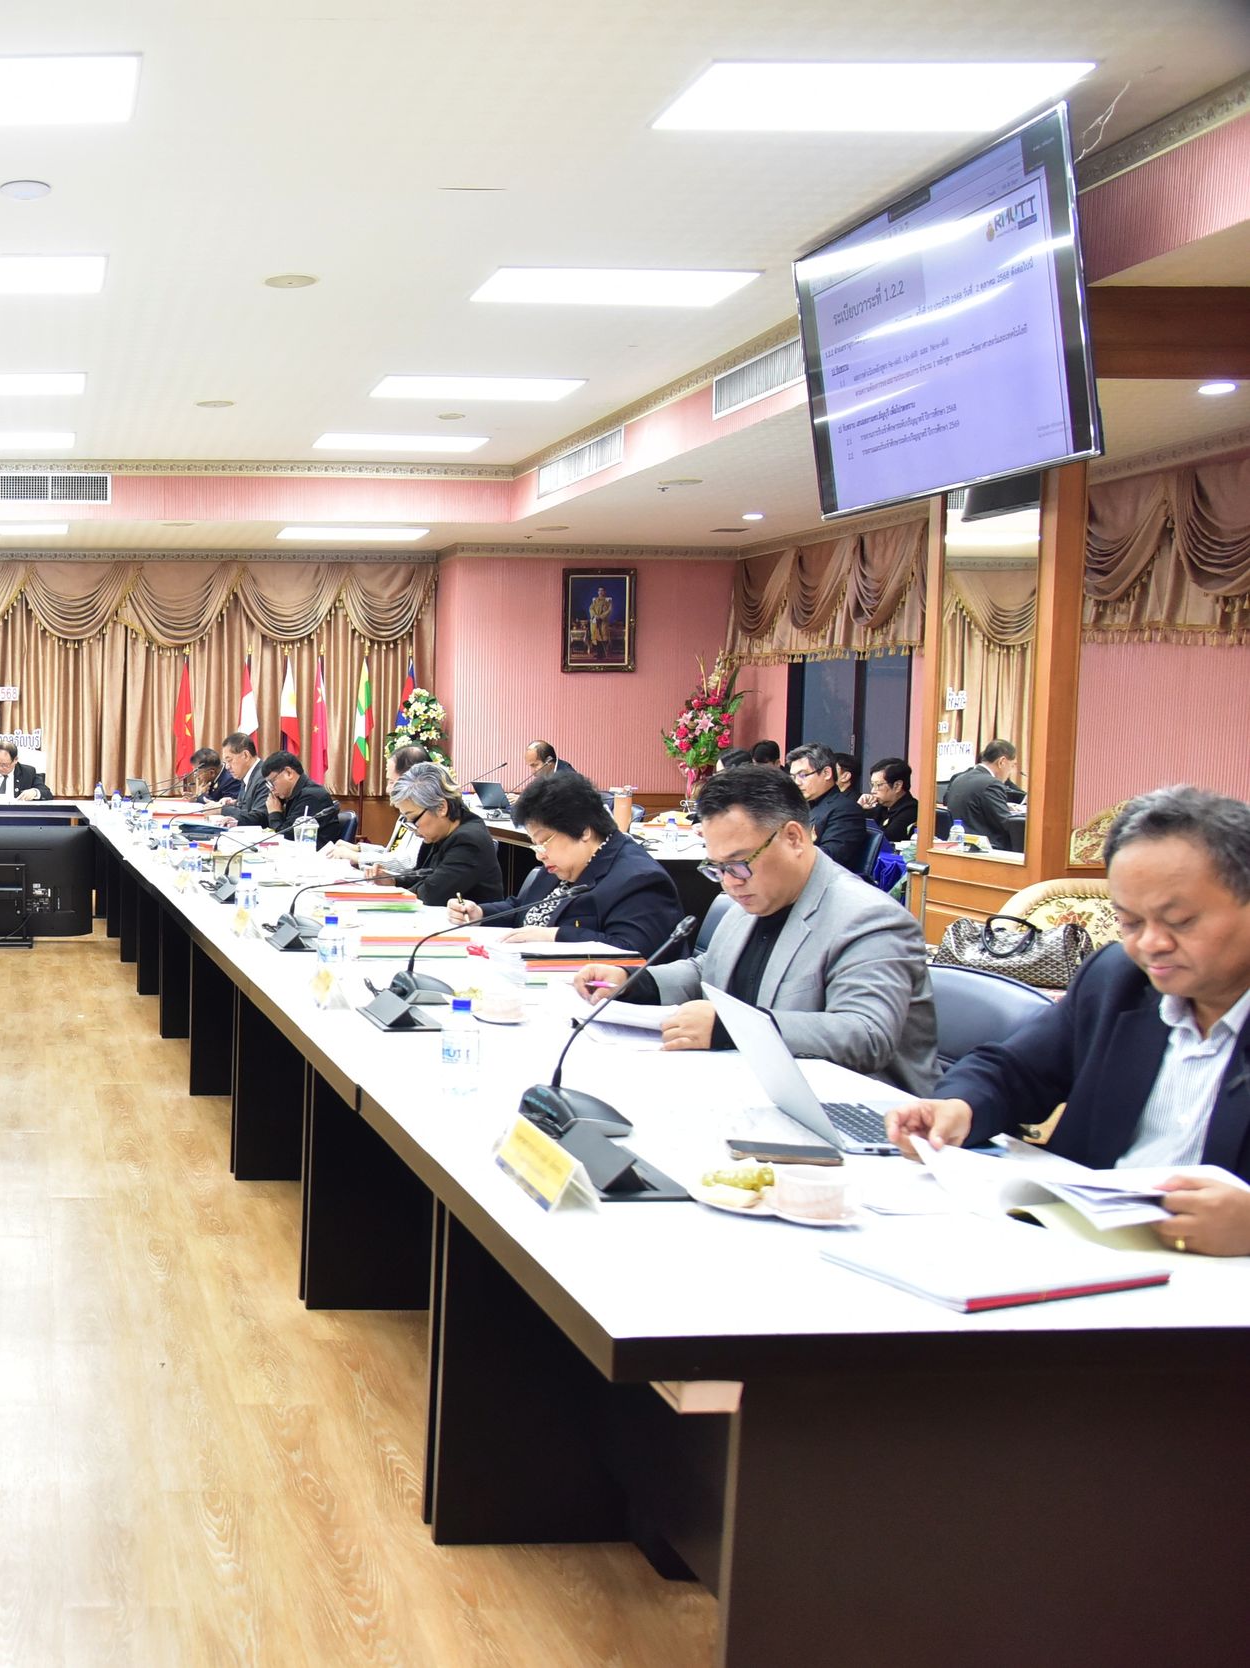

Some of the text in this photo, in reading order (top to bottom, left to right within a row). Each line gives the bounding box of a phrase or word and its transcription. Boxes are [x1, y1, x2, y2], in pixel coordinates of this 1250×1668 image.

[833, 280, 904, 326] ระเบียบวาระที่ 1.2.2
